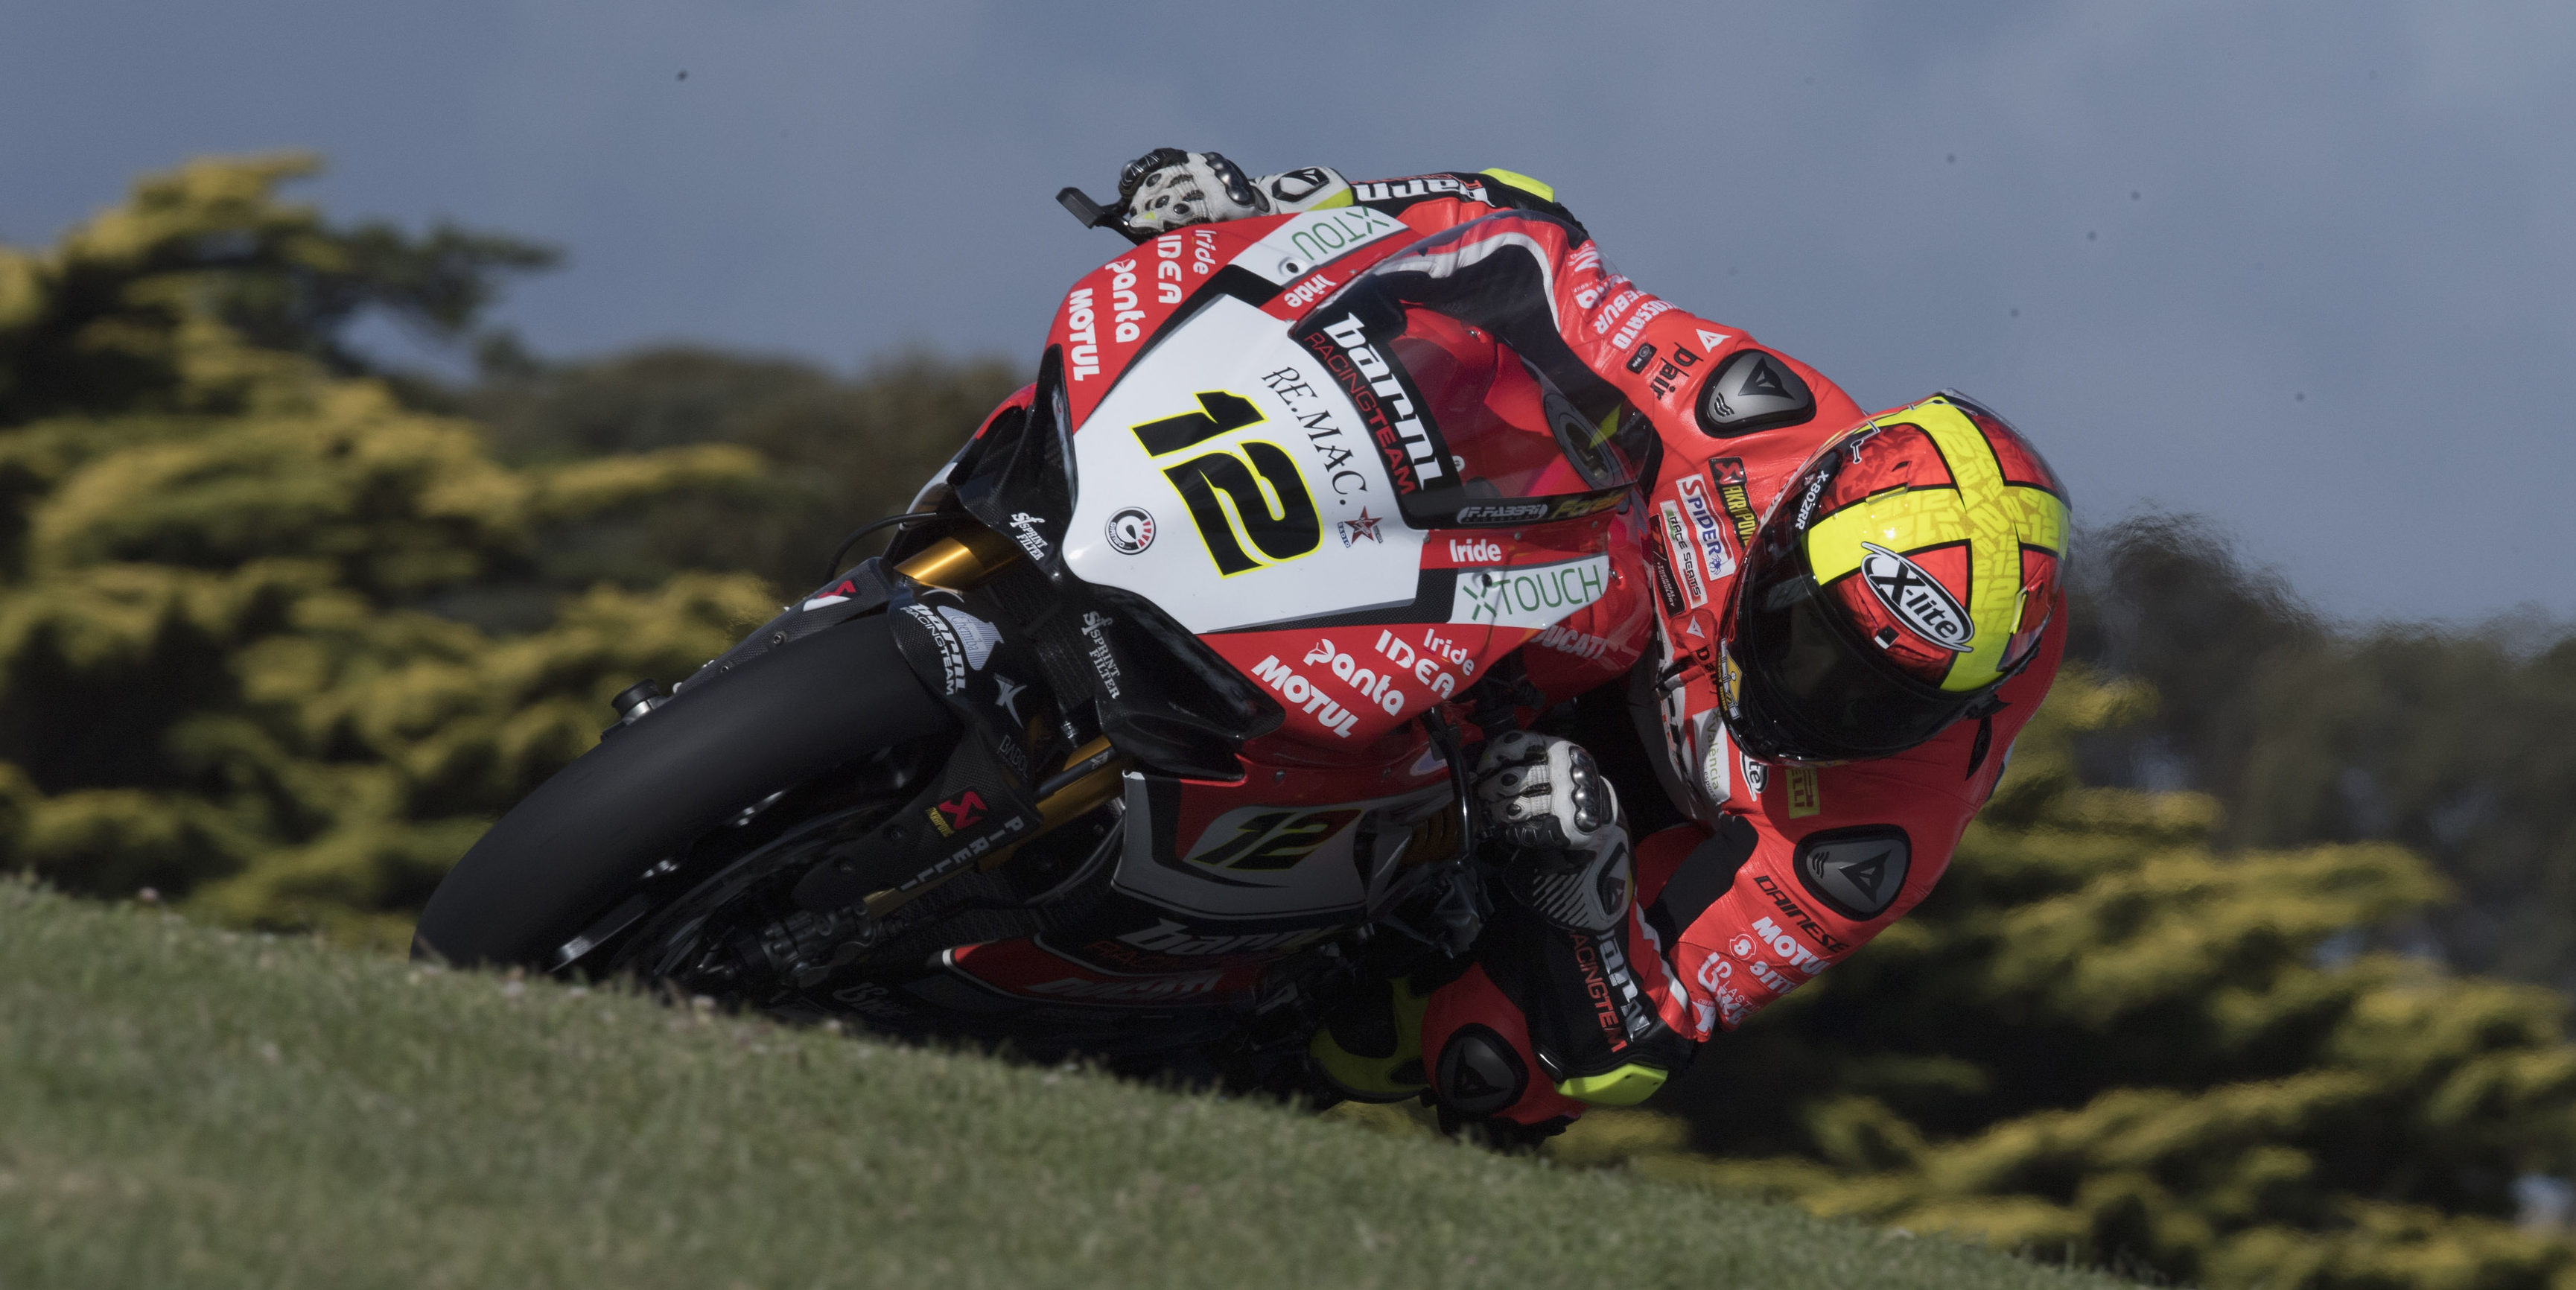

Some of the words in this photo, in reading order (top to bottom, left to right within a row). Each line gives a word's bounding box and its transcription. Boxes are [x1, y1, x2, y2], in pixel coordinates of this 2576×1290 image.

[1352, 178, 1495, 208] barn
[1158, 235, 1182, 304] IDEA
[1193, 229, 1218, 275] Iride
[1284, 274, 1336, 308] Iride
[1069, 287, 1101, 381] MOTUL
[1304, 333, 1416, 495] RACINGTEAM
[1323, 311, 1443, 491] barni
[1262, 366, 1369, 506] RE.MAC.
[1130, 390, 1322, 579] 12
[1796, 470, 1829, 530] X-802RR
[1016, 533, 1045, 560] FILTER
[1019, 523, 1048, 548] SPRINT
[1449, 538, 1502, 562] Iride
[1683, 480, 1722, 556] SPIDER
[1670, 515, 1688, 550] RACE
[1683, 552, 1701, 596] SEATS
[1462, 565, 1604, 620] XTOUCH
[1869, 559, 1958, 640] X-lite
[899, 607, 954, 696] RACINGTEAM
[1089, 649, 1120, 699] FILTER
[1090, 629, 1120, 677] SPRINT
[1375, 629, 1454, 699] IDEA
[1424, 628, 1475, 676] Iride
[1251, 655, 1359, 738] MOTUL
[1792, 769, 1805, 807] ELLI
[900, 816, 1024, 891] PIRELLI
[1192, 809, 1362, 870] 12
[1752, 916, 1831, 975] MOTU
[1754, 875, 1850, 953] DAINESE
